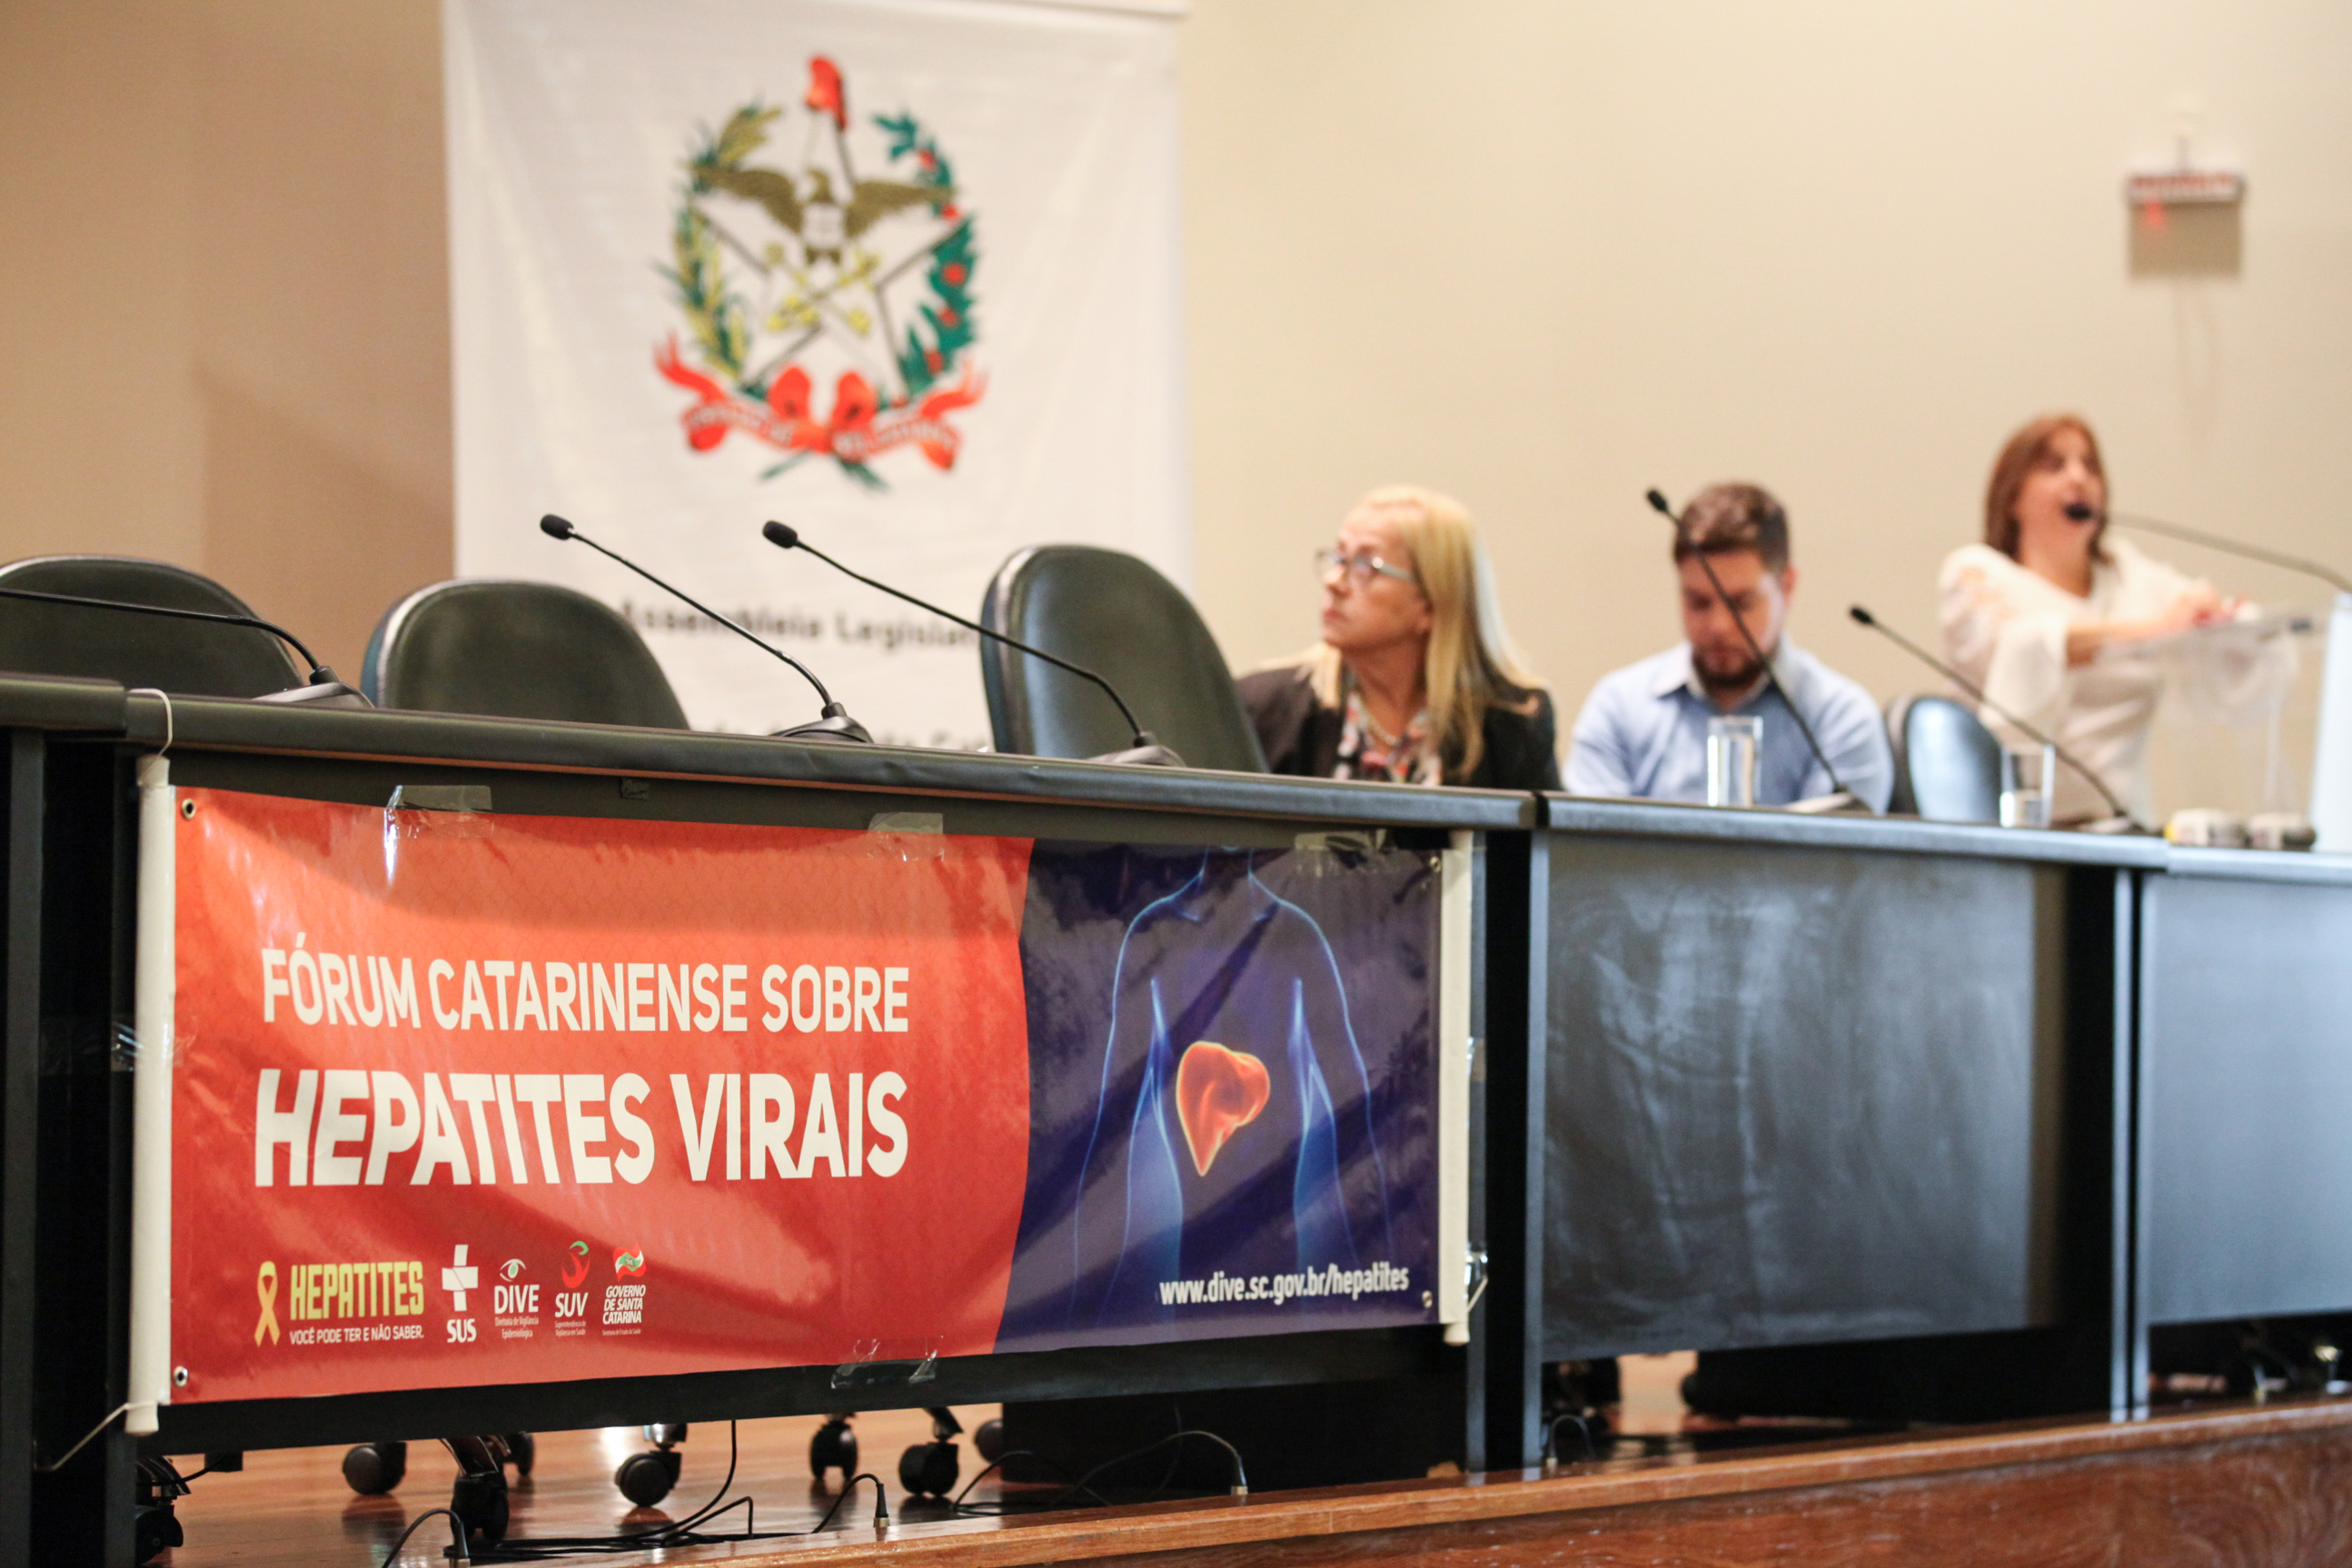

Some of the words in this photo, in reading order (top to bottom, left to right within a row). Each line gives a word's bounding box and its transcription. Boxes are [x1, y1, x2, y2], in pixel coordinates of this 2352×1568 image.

[262, 932, 422, 1028] FÓRUM
[429, 958, 748, 1032] CATARINENSE
[761, 964, 909, 1033] SOBRE
[254, 1068, 655, 1187] HEPATITES
[670, 1071, 908, 1182] VIRAIS
[291, 1261, 424, 1320] HEPATITES
[605, 1285, 646, 1298] GOVERNO
[1159, 1261, 1409, 1306] www.dive.sc.gov.br/hepatites
[493, 1284, 540, 1315] DIVE
[554, 1292, 589, 1318] SUV
[603, 1298, 616, 1311] DE
[616, 1297, 643, 1311] SANTA
[602, 1310, 642, 1325] CATARINA
[316, 1327, 342, 1344] PODE
[343, 1326, 362, 1342] TER
[363, 1326, 370, 1341] E
[371, 1324, 392, 1341] NÃO
[392, 1325, 424, 1340] SABER.
[446, 1318, 477, 1344] SUS
